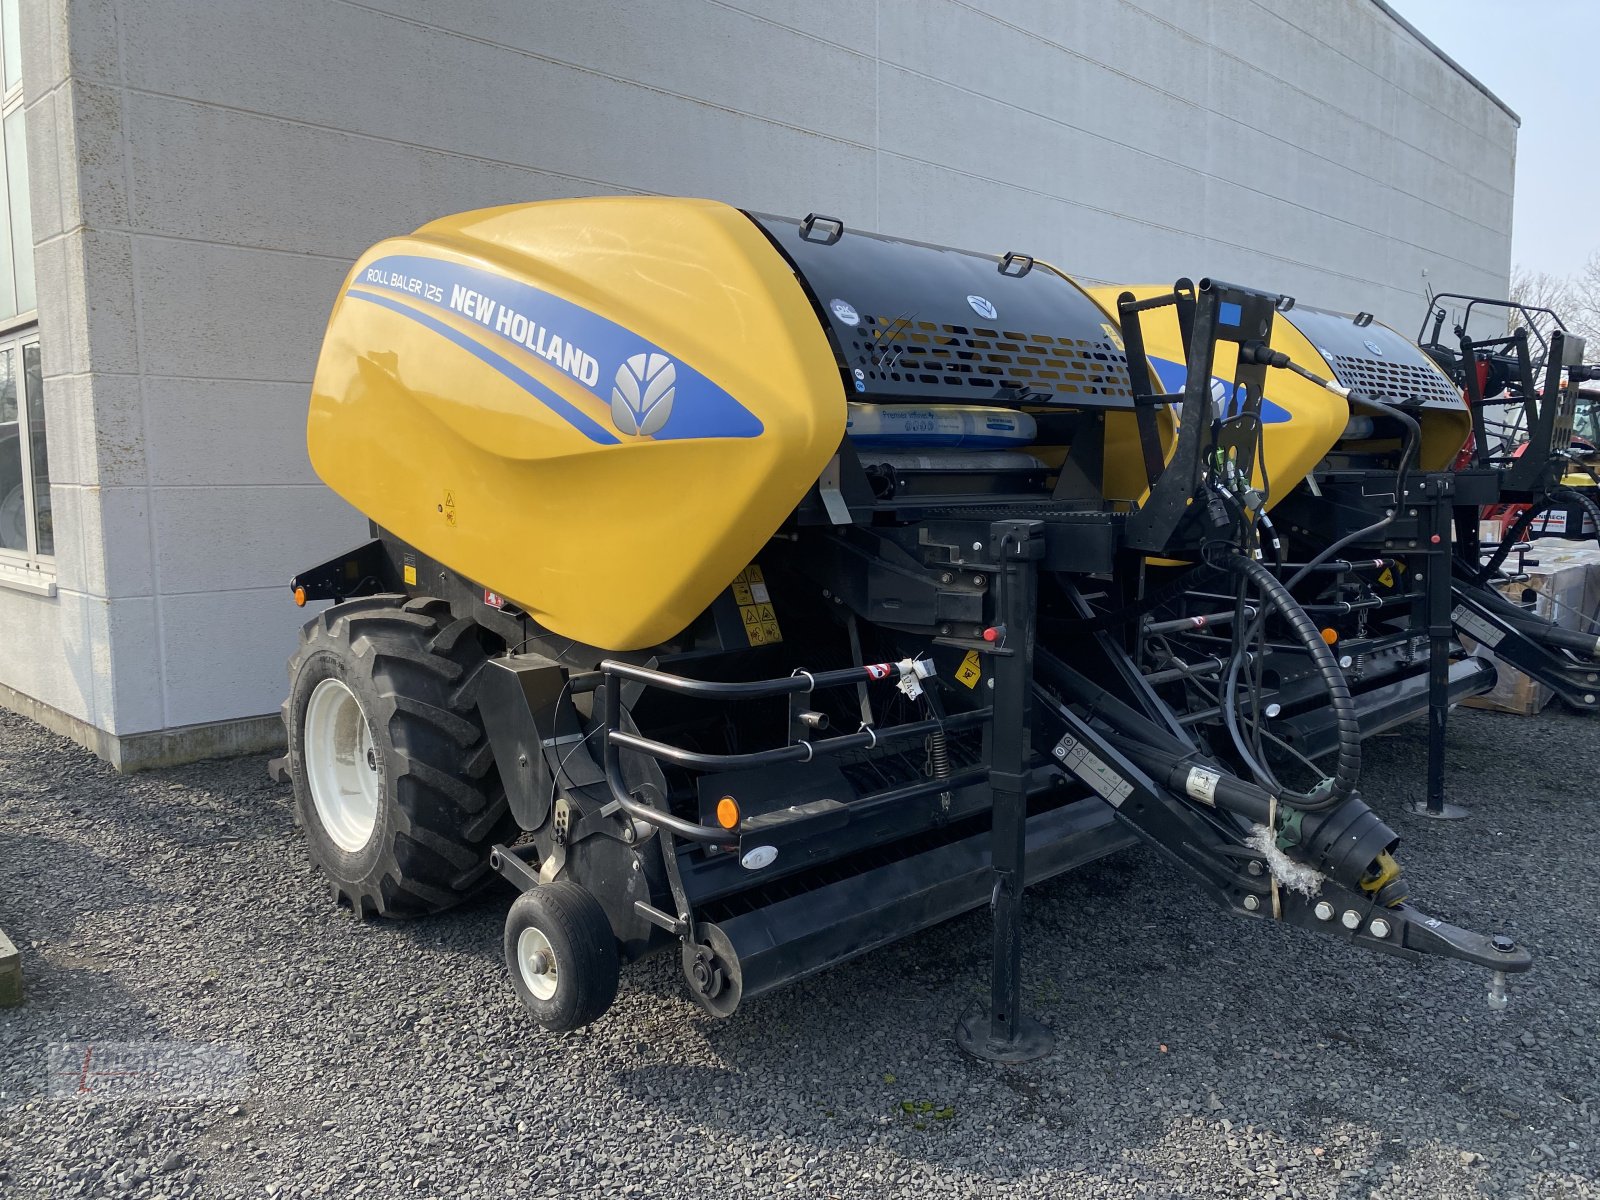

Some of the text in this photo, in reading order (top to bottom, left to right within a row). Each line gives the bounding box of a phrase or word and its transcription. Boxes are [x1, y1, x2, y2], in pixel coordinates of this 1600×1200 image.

[366, 268, 444, 303] ROLL BALER 125
[449, 283, 600, 388] NEW HOLLAND
